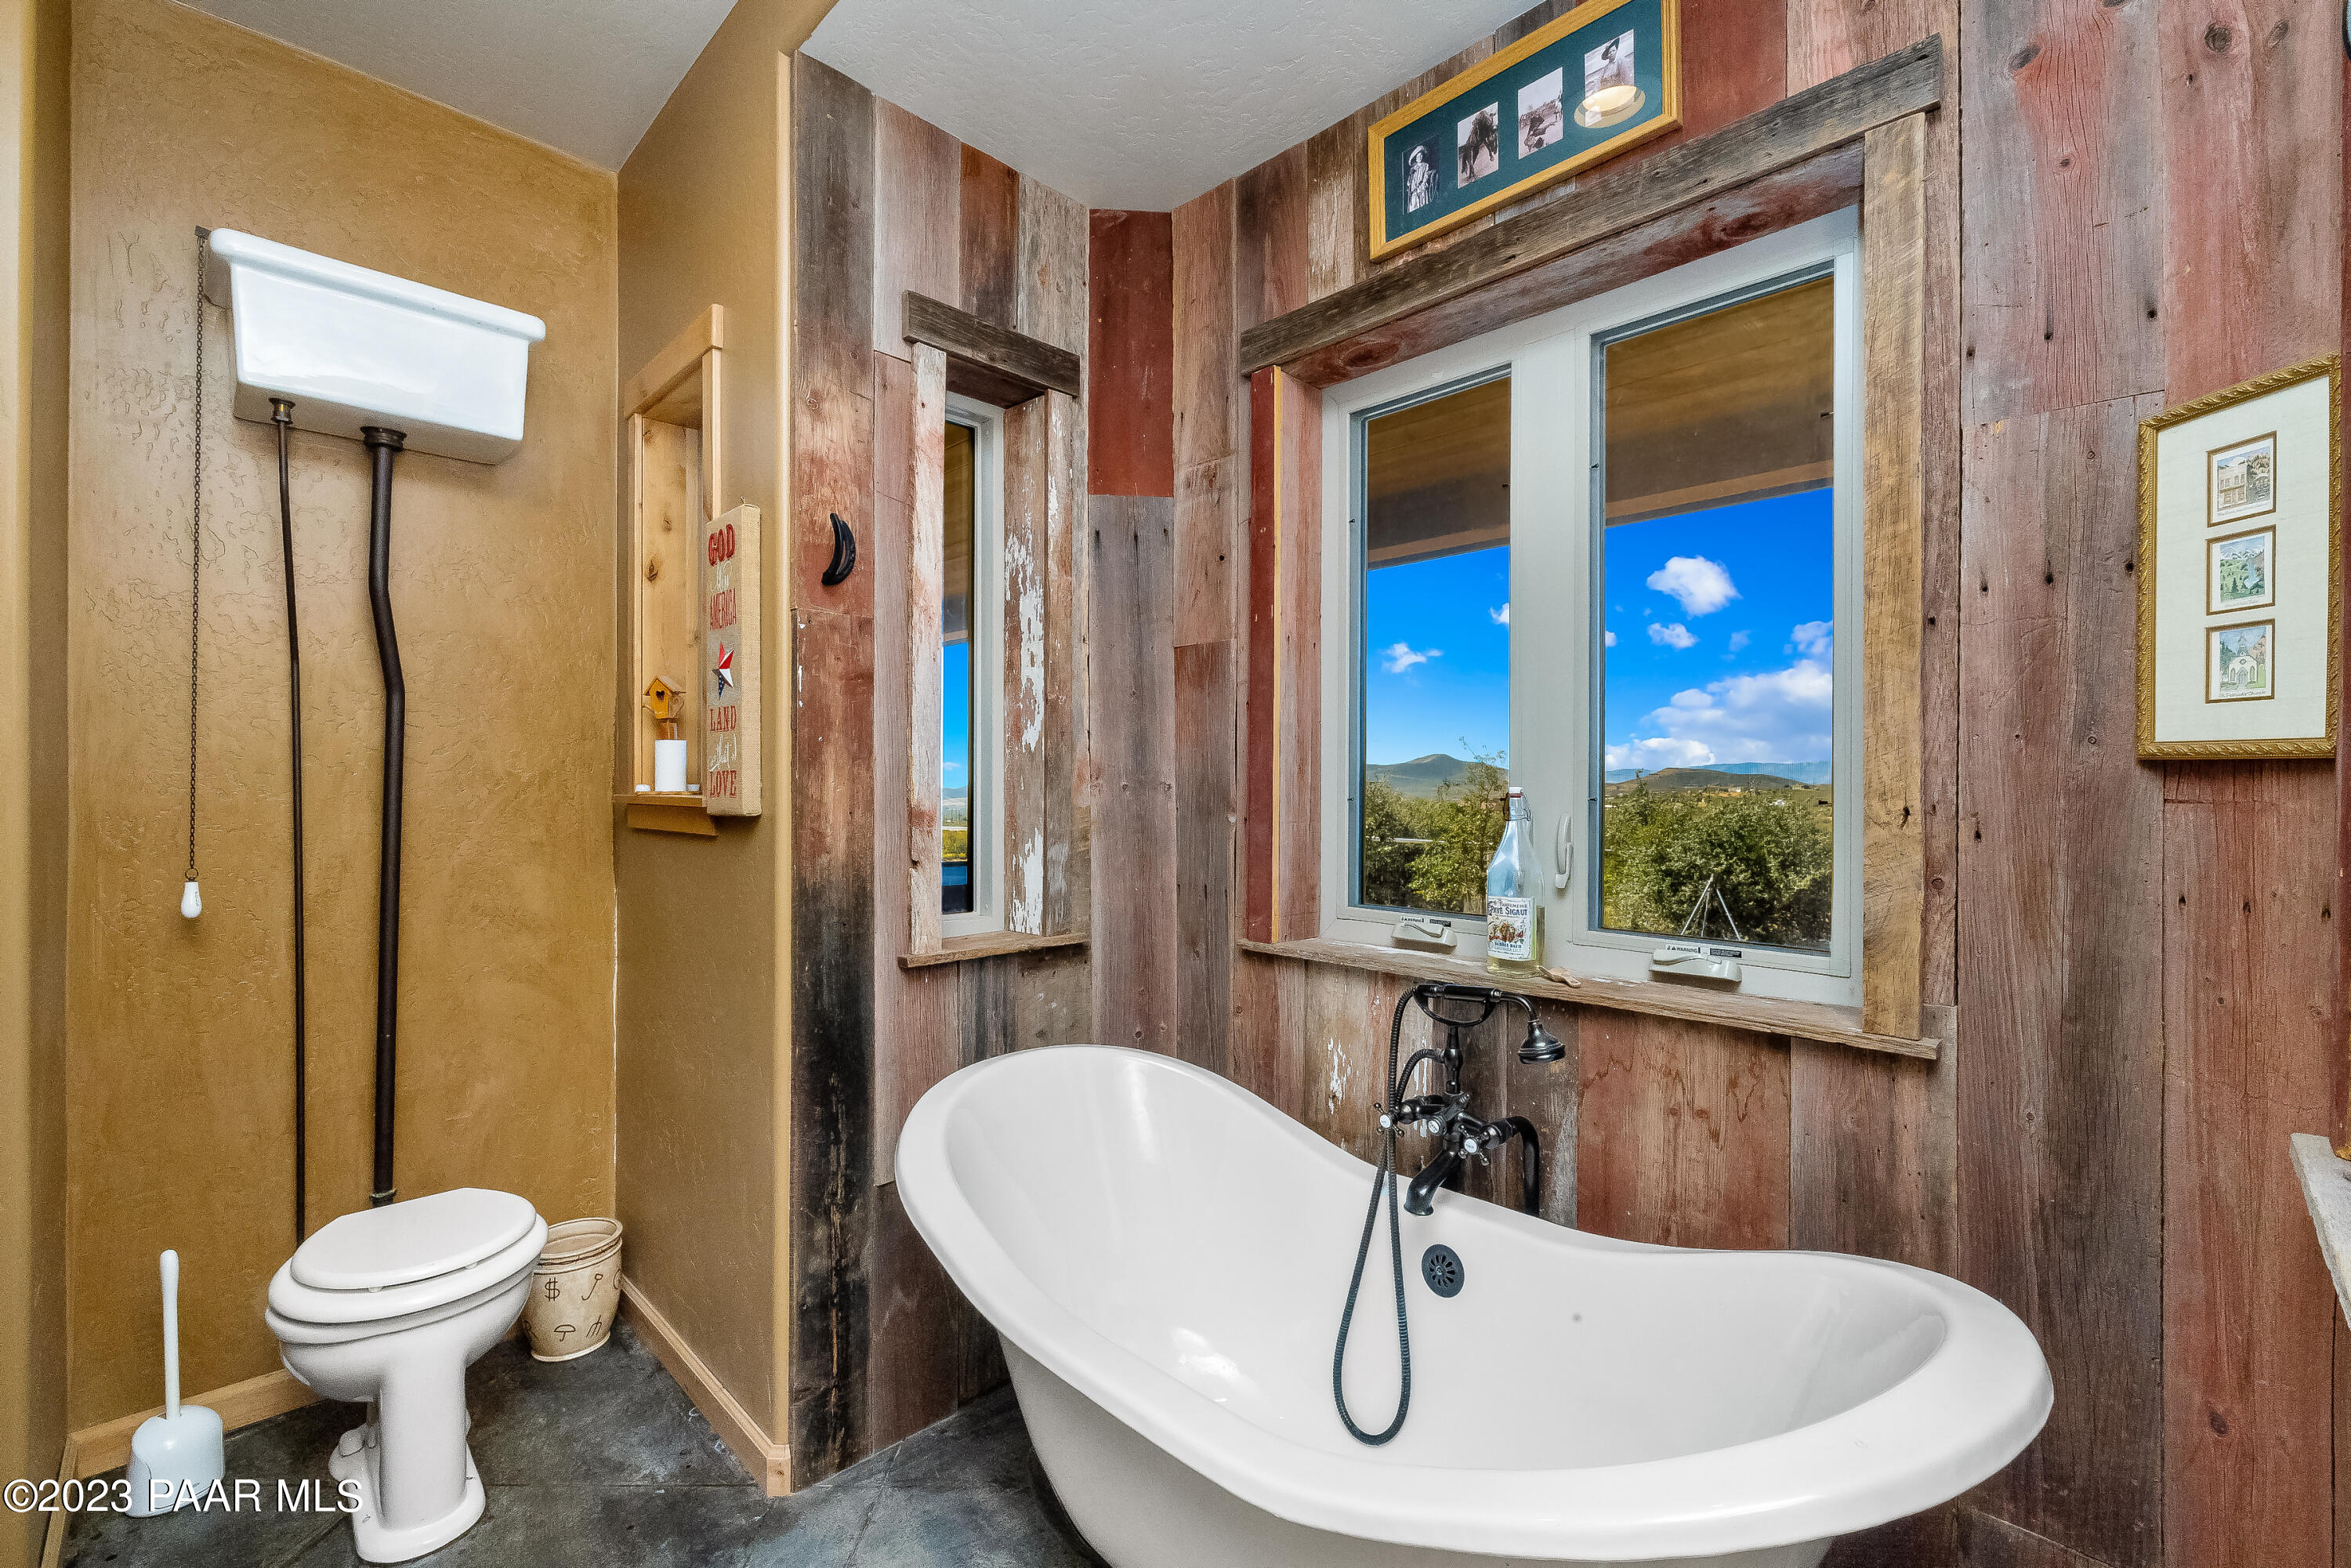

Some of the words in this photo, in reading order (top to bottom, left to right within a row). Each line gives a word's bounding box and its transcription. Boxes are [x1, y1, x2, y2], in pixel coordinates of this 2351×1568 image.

[708, 523, 736, 567] GOD
[710, 587, 737, 631] AMERICA
[709, 705, 737, 732] LAND
[709, 770, 737, 798] LOVE
